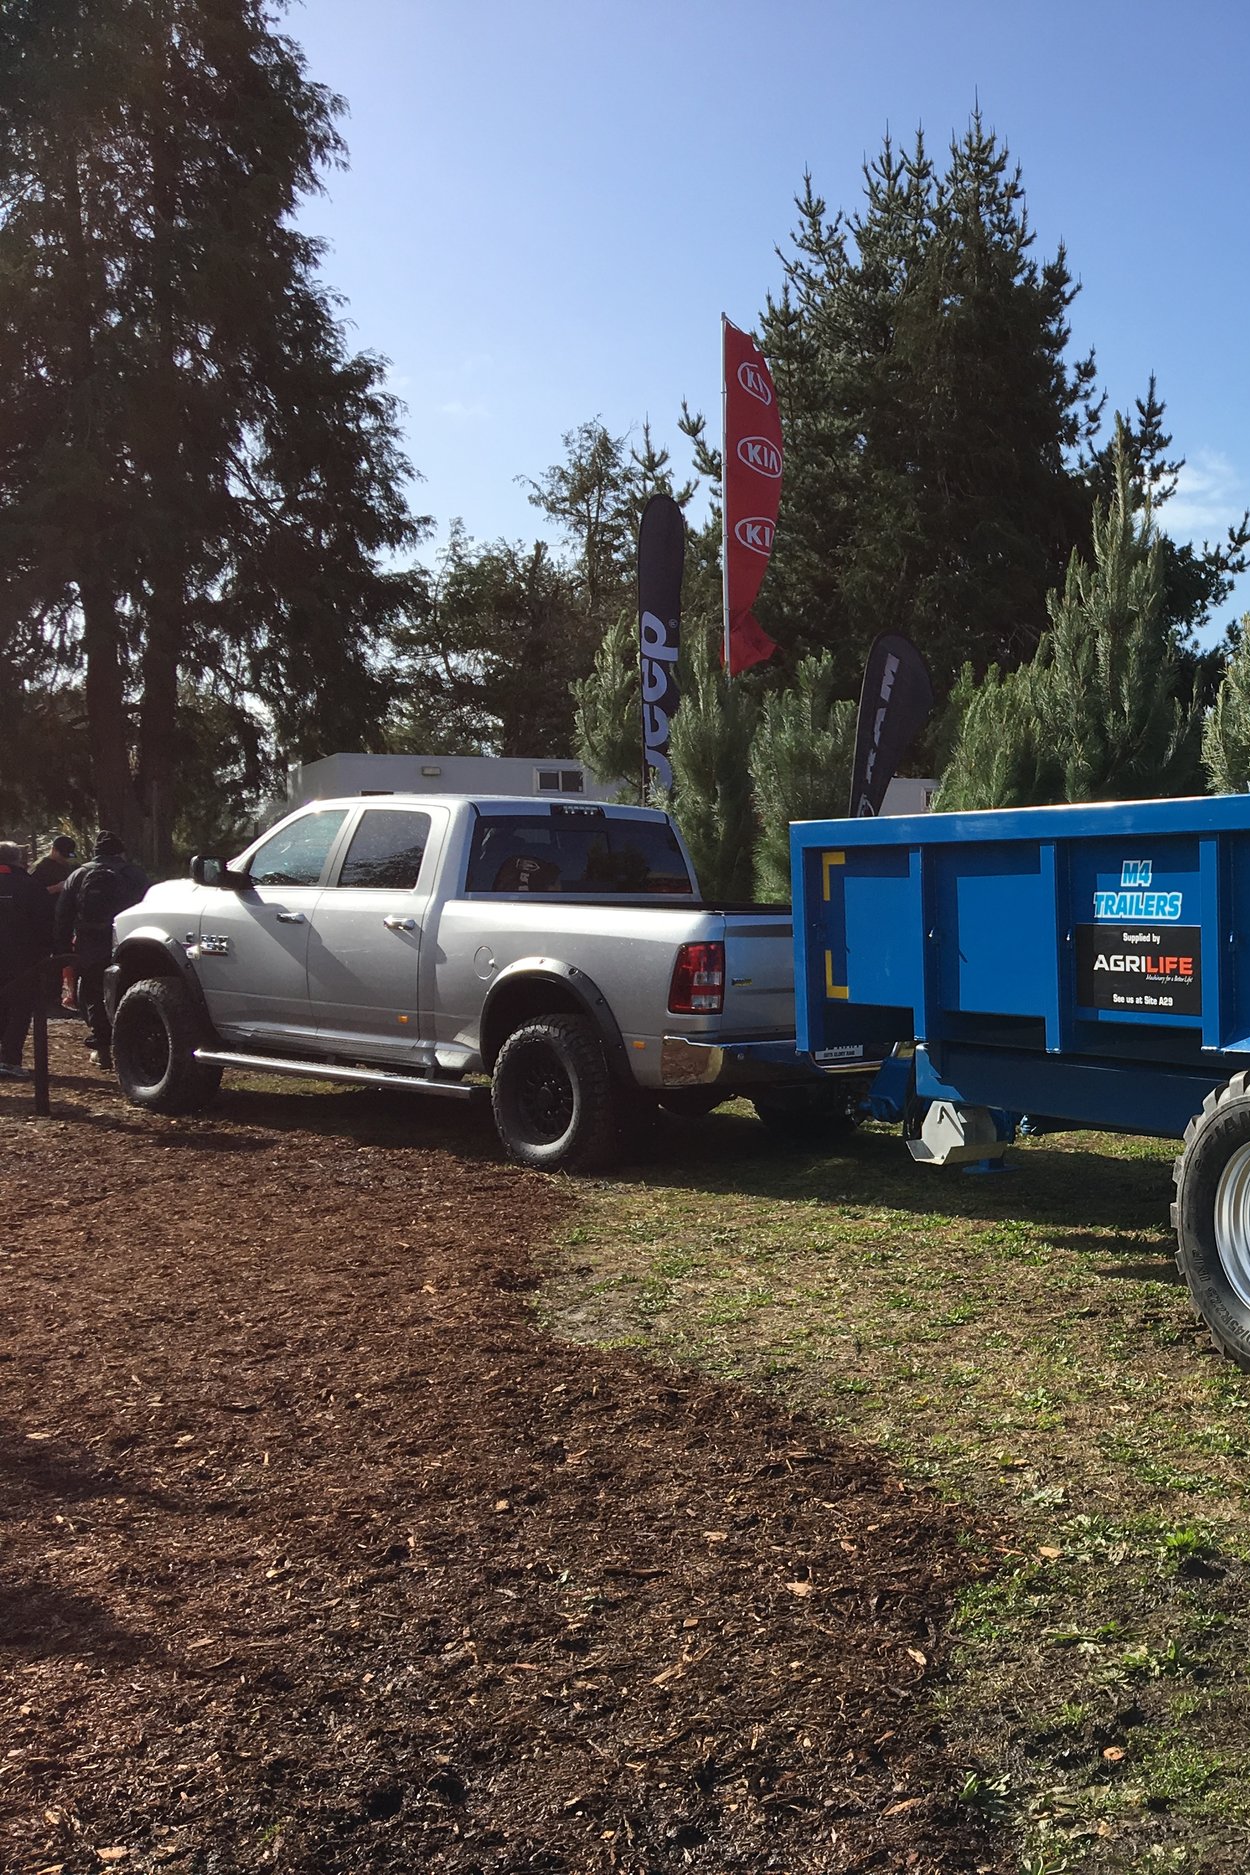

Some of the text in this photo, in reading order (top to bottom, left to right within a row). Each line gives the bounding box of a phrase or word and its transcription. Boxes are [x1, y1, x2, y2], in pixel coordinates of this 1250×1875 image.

[1120, 860, 1152, 887] M4
[1093, 892, 1182, 920] TRAILERS
[1122, 932, 1161, 945] Supplied by
[1093, 954, 1193, 975] AGRILIFE
[1112, 993, 1174, 1007] See us at Site A29
